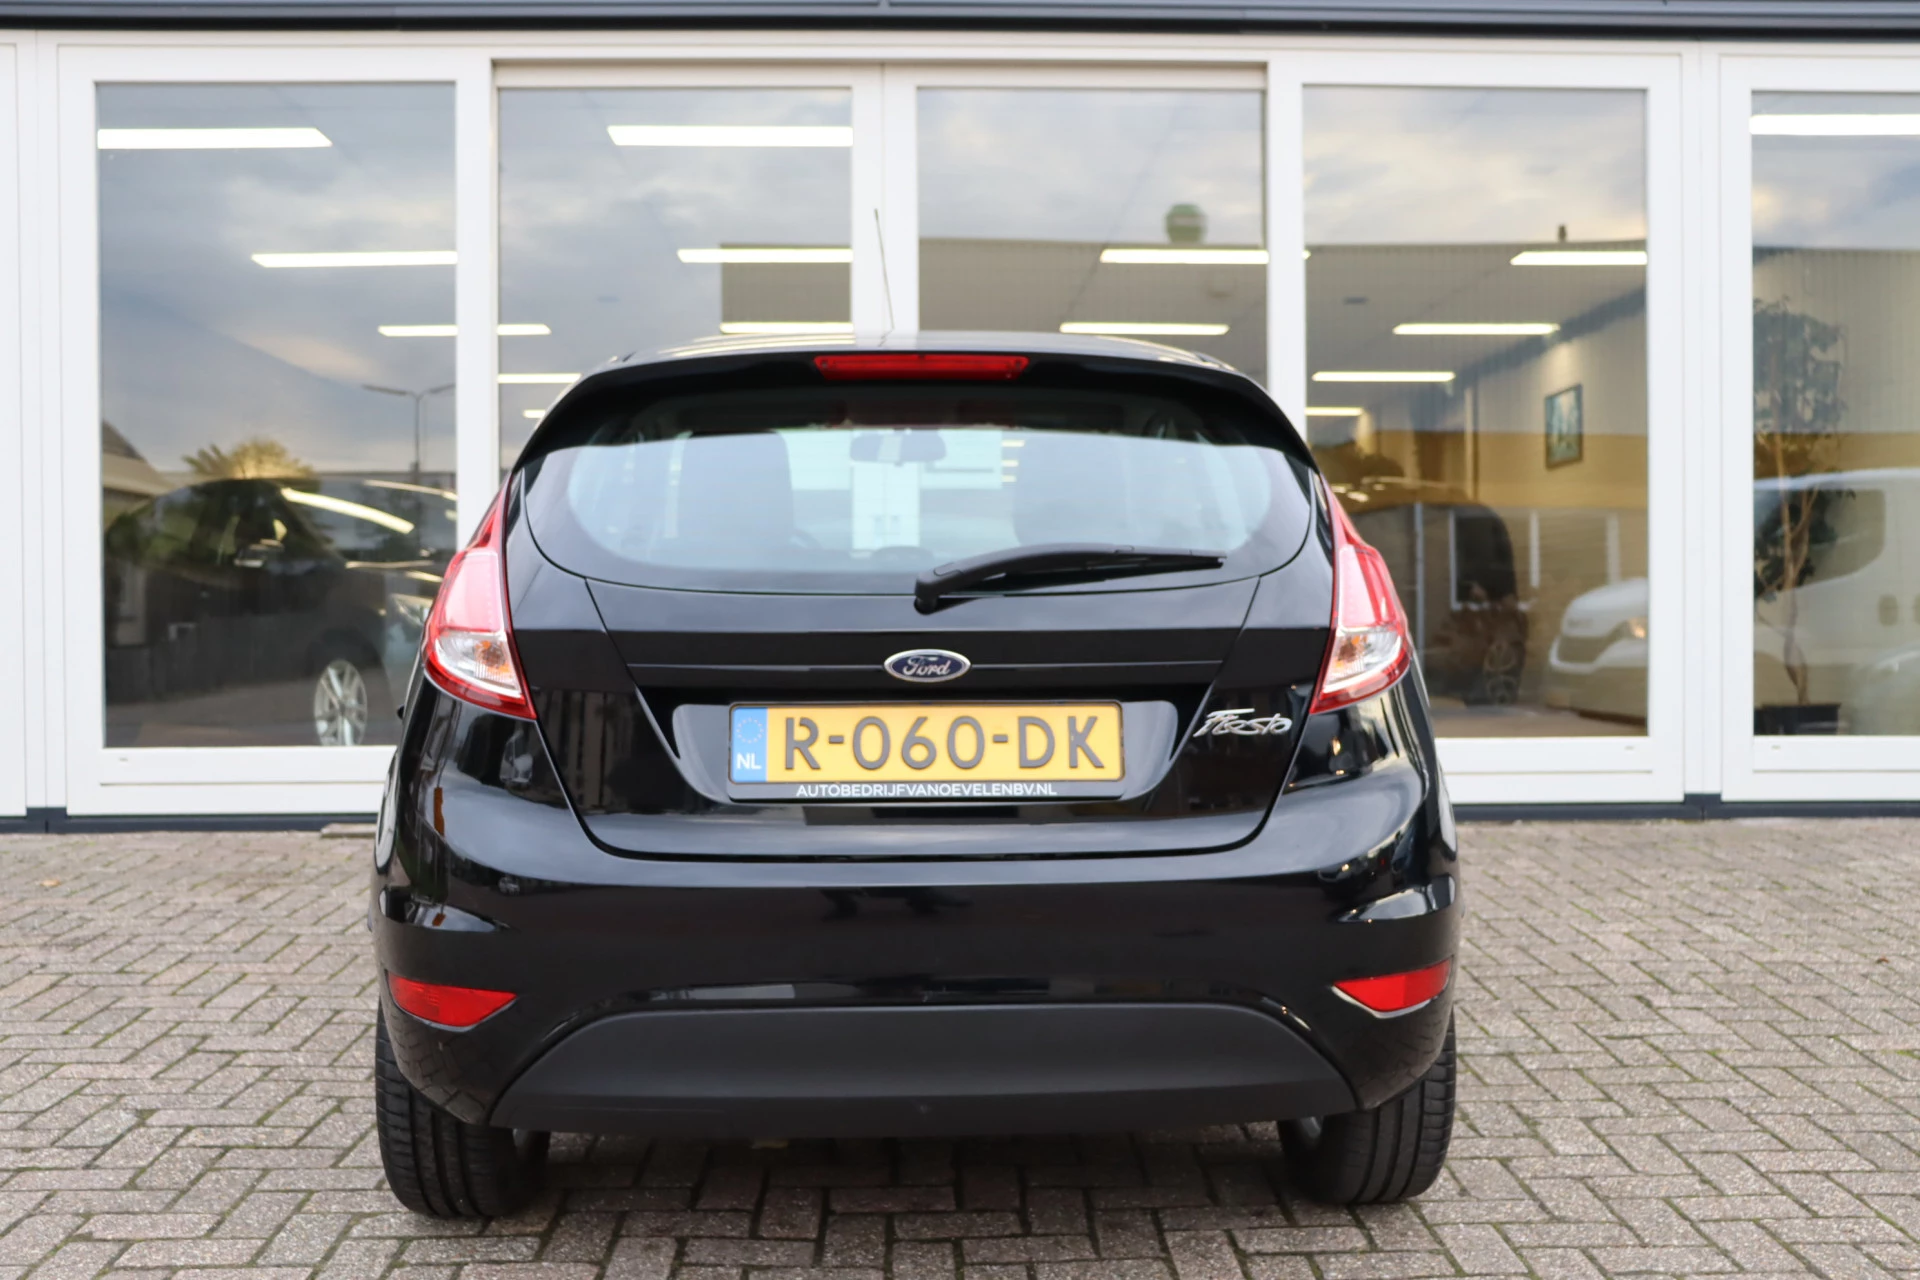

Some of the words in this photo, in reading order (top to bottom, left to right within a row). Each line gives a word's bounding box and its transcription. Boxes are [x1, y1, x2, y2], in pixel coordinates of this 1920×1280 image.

[902, 654, 952, 676] Ford
[1192, 708, 1292, 738] Fiesta
[785, 715, 1105, 771] R-060-DK
[736, 753, 762, 770] NL
[795, 783, 1058, 798] AUTOBEDRIJFVANOEVELENBV.NL
